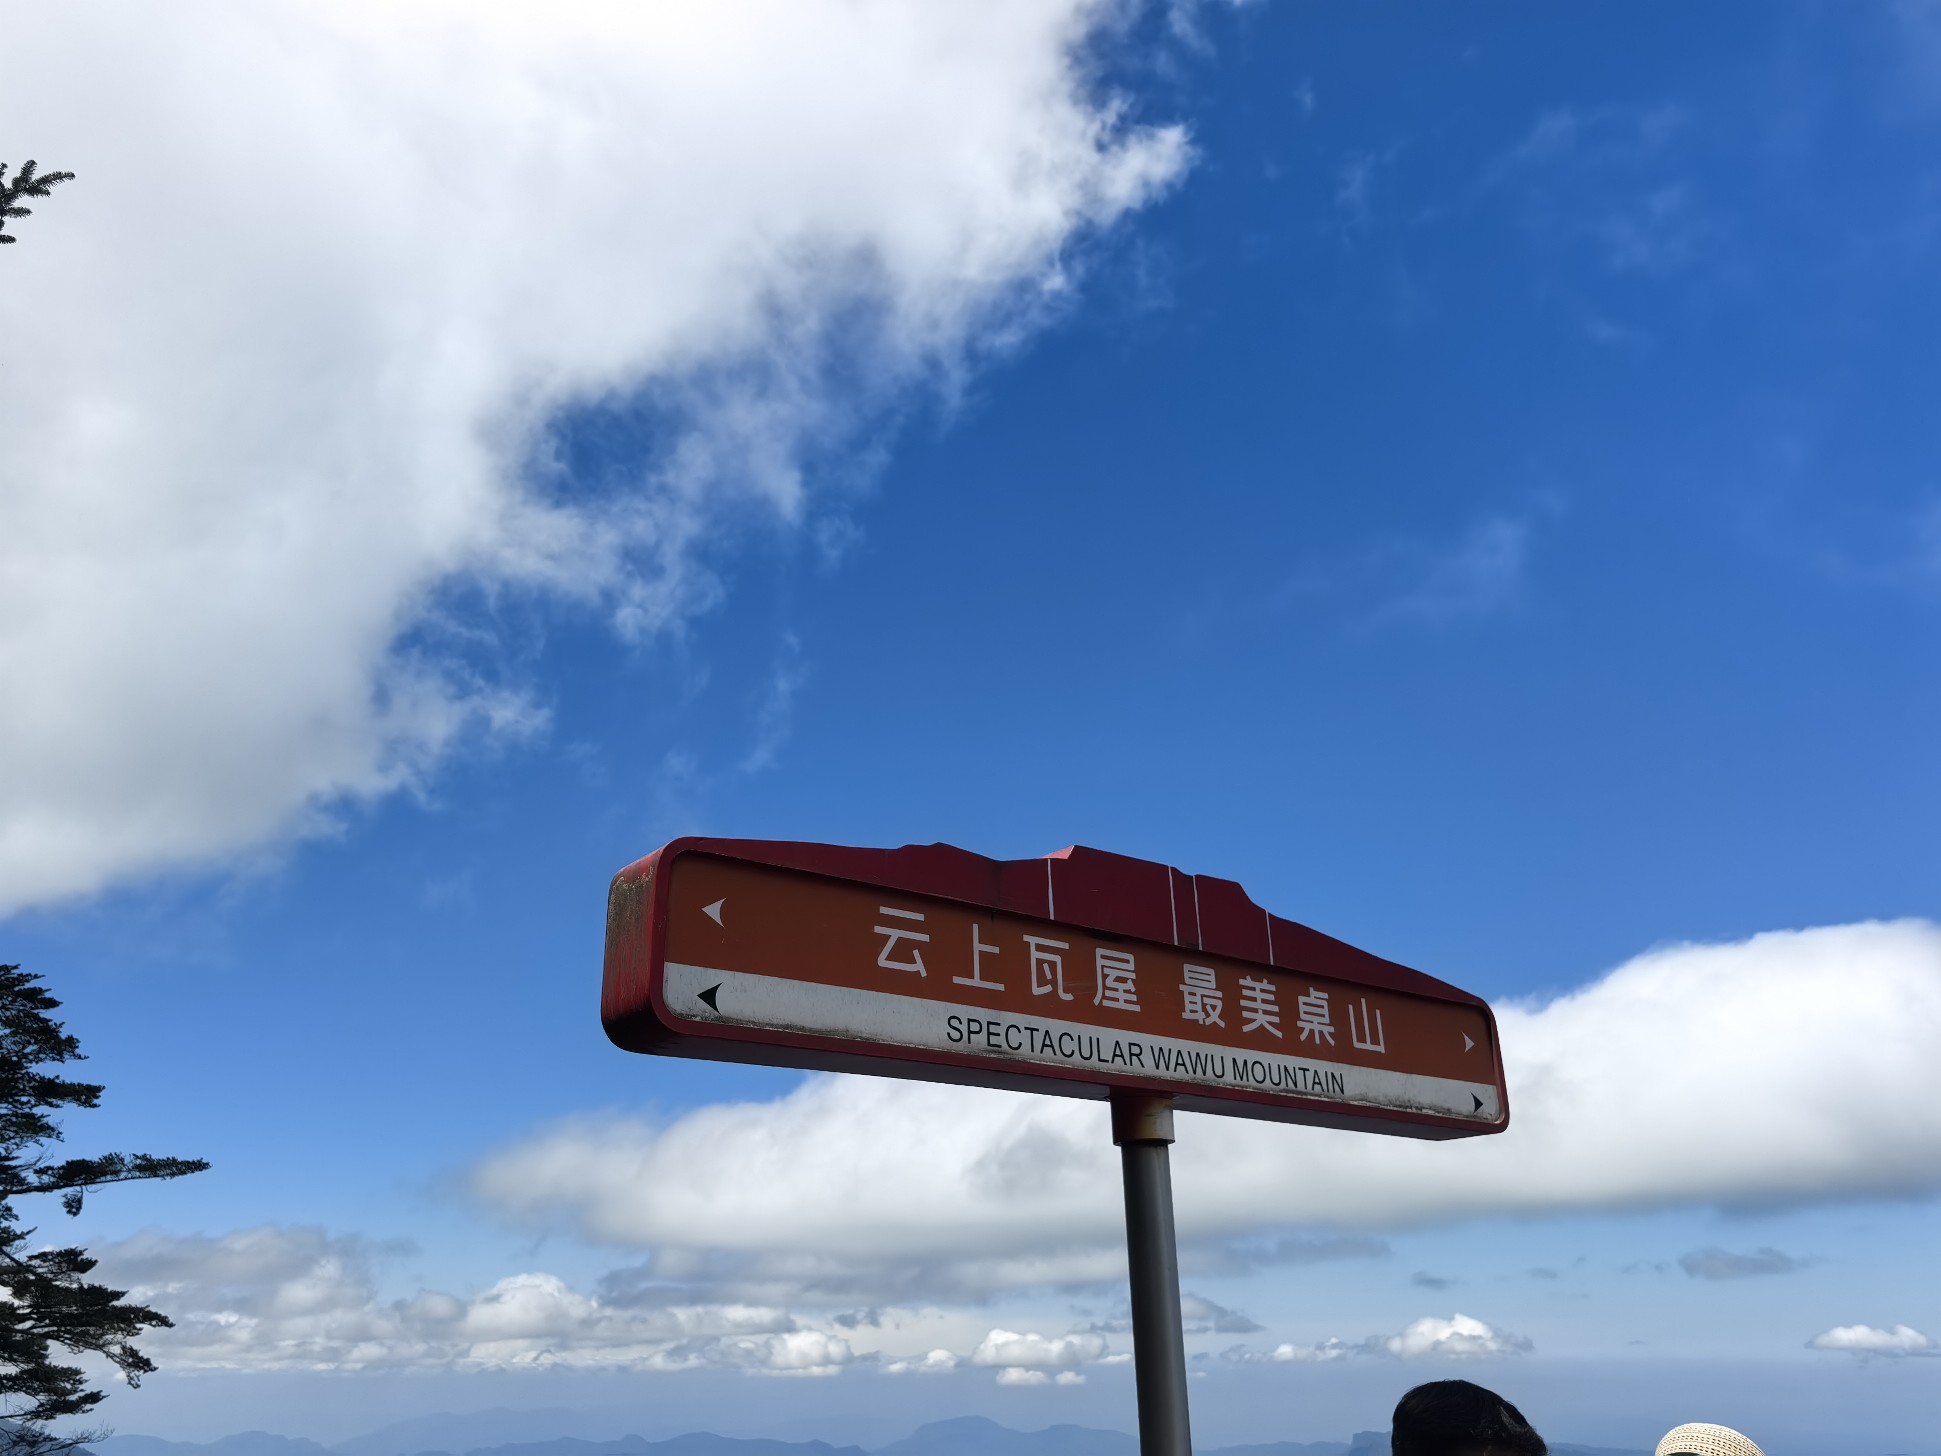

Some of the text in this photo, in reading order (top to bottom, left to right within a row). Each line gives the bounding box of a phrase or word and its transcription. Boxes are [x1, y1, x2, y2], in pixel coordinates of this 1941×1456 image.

[874, 906, 1385, 1054] 云上瓦屋 最美桌山
[946, 1015, 1345, 1096] SPECTACULAR WAWU MOUNTAIN
